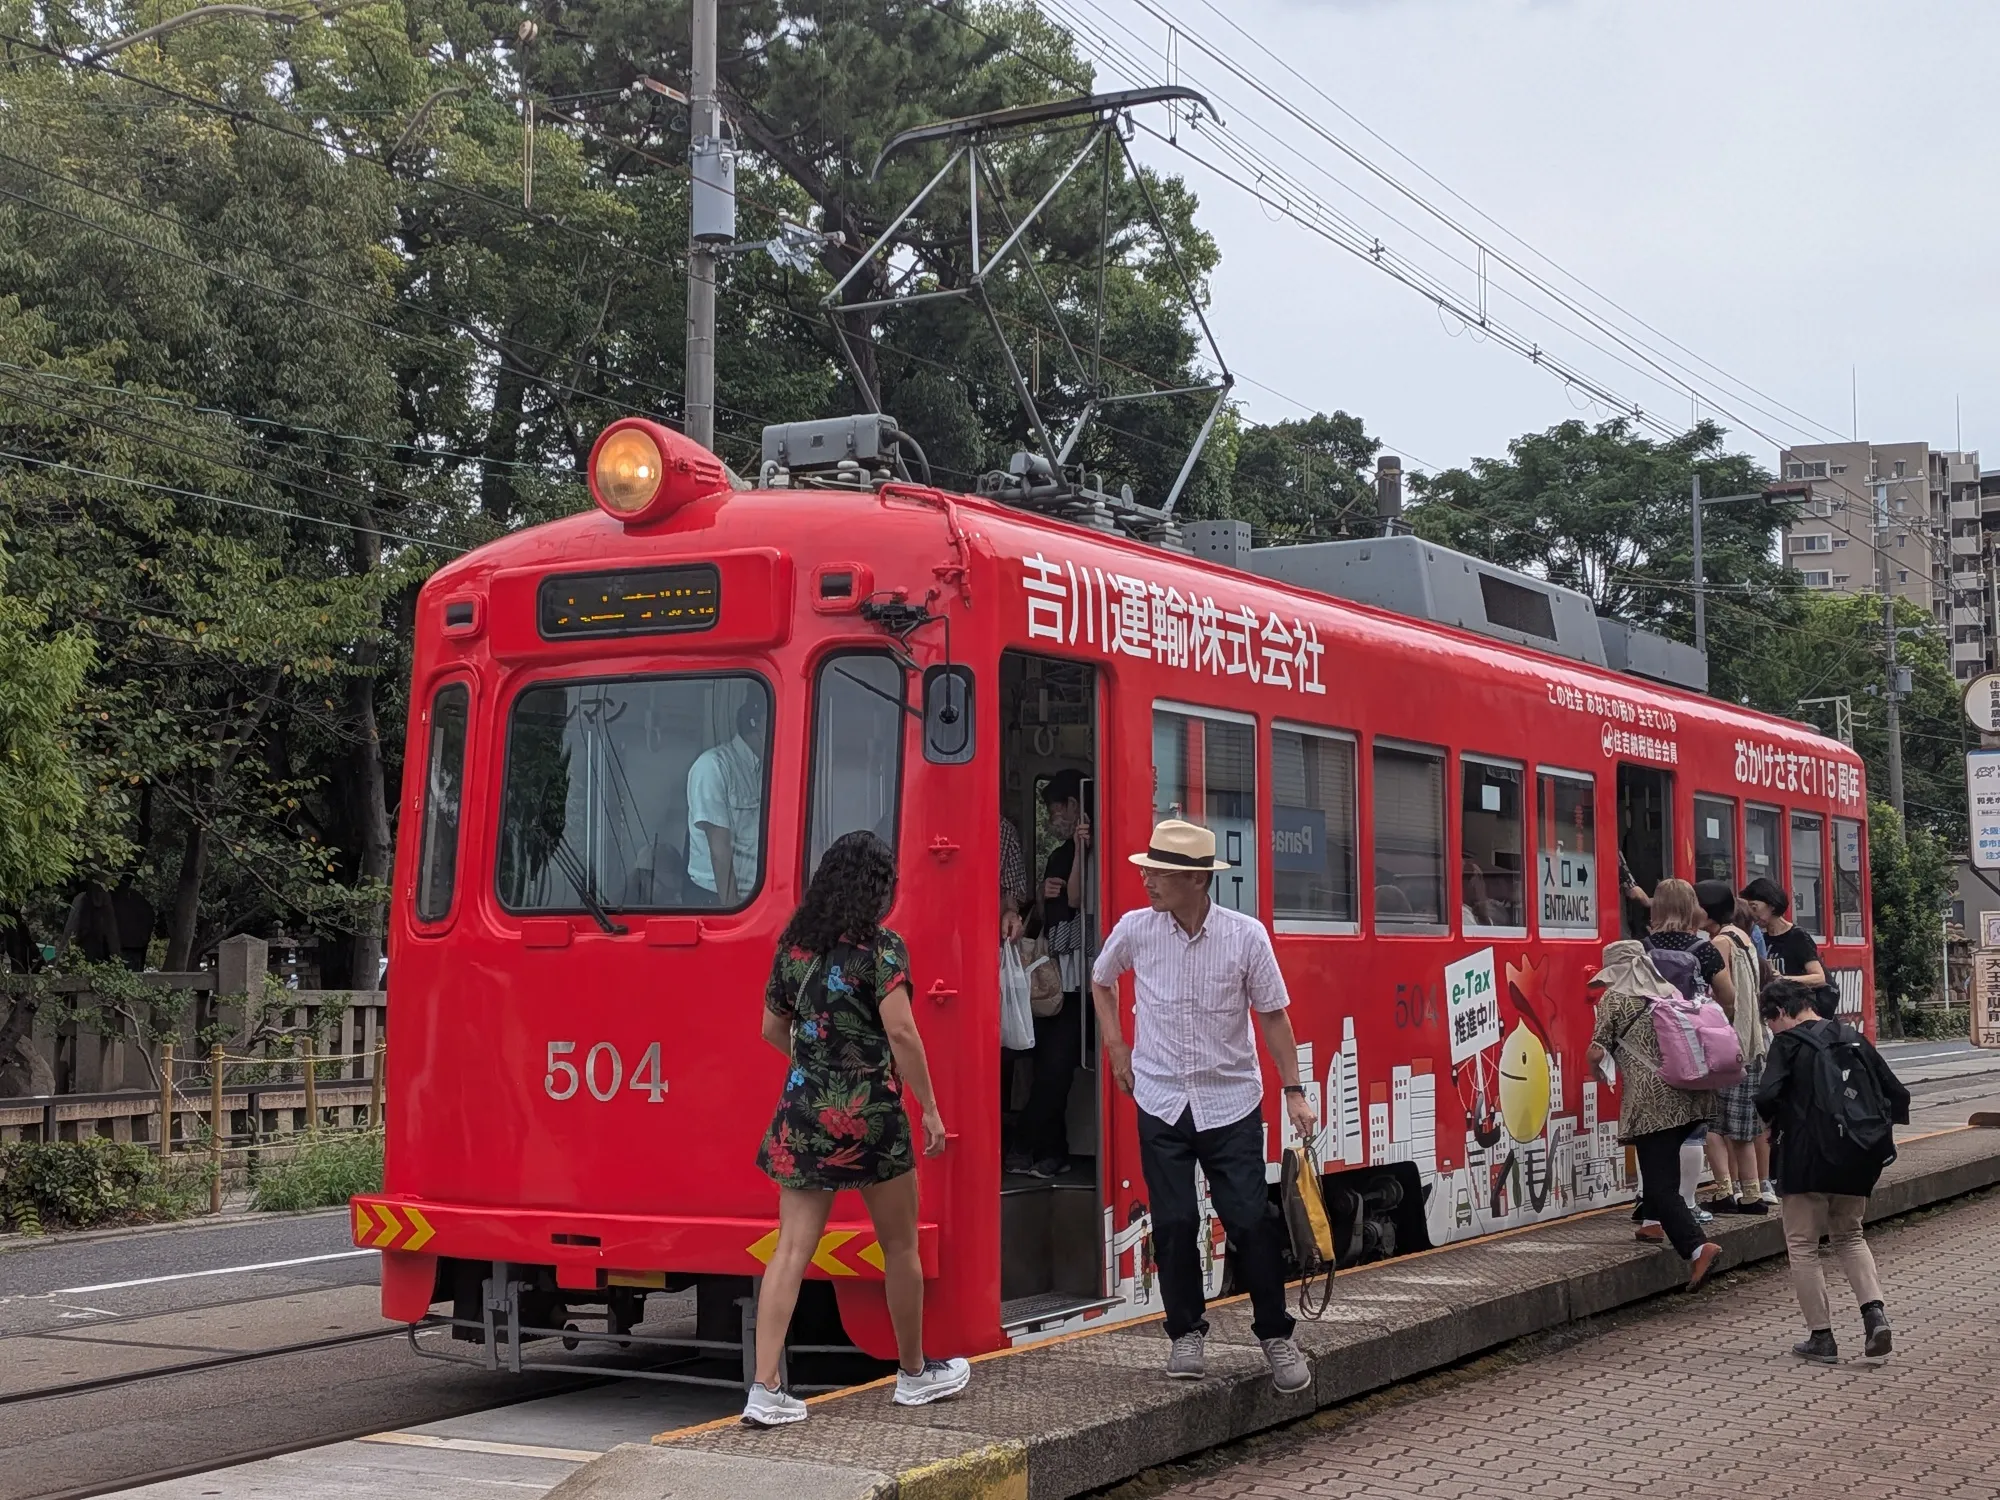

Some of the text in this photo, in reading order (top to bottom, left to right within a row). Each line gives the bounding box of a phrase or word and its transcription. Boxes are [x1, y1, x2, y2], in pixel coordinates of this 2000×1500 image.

[1022, 552, 1326, 695] 吉川運輸株式会社
[1546, 683, 1584, 712] この社会
[1637, 705, 1677, 732] 生きている
[1735, 738, 1860, 807] おかげさまで115周年
[1543, 856, 1572, 888] 入口
[1544, 893, 1590, 922] ENTRANCE
[1396, 983, 1439, 1029] 504
[1452, 969, 1491, 1005] e-Tax
[544, 1041, 669, 1103] 504
